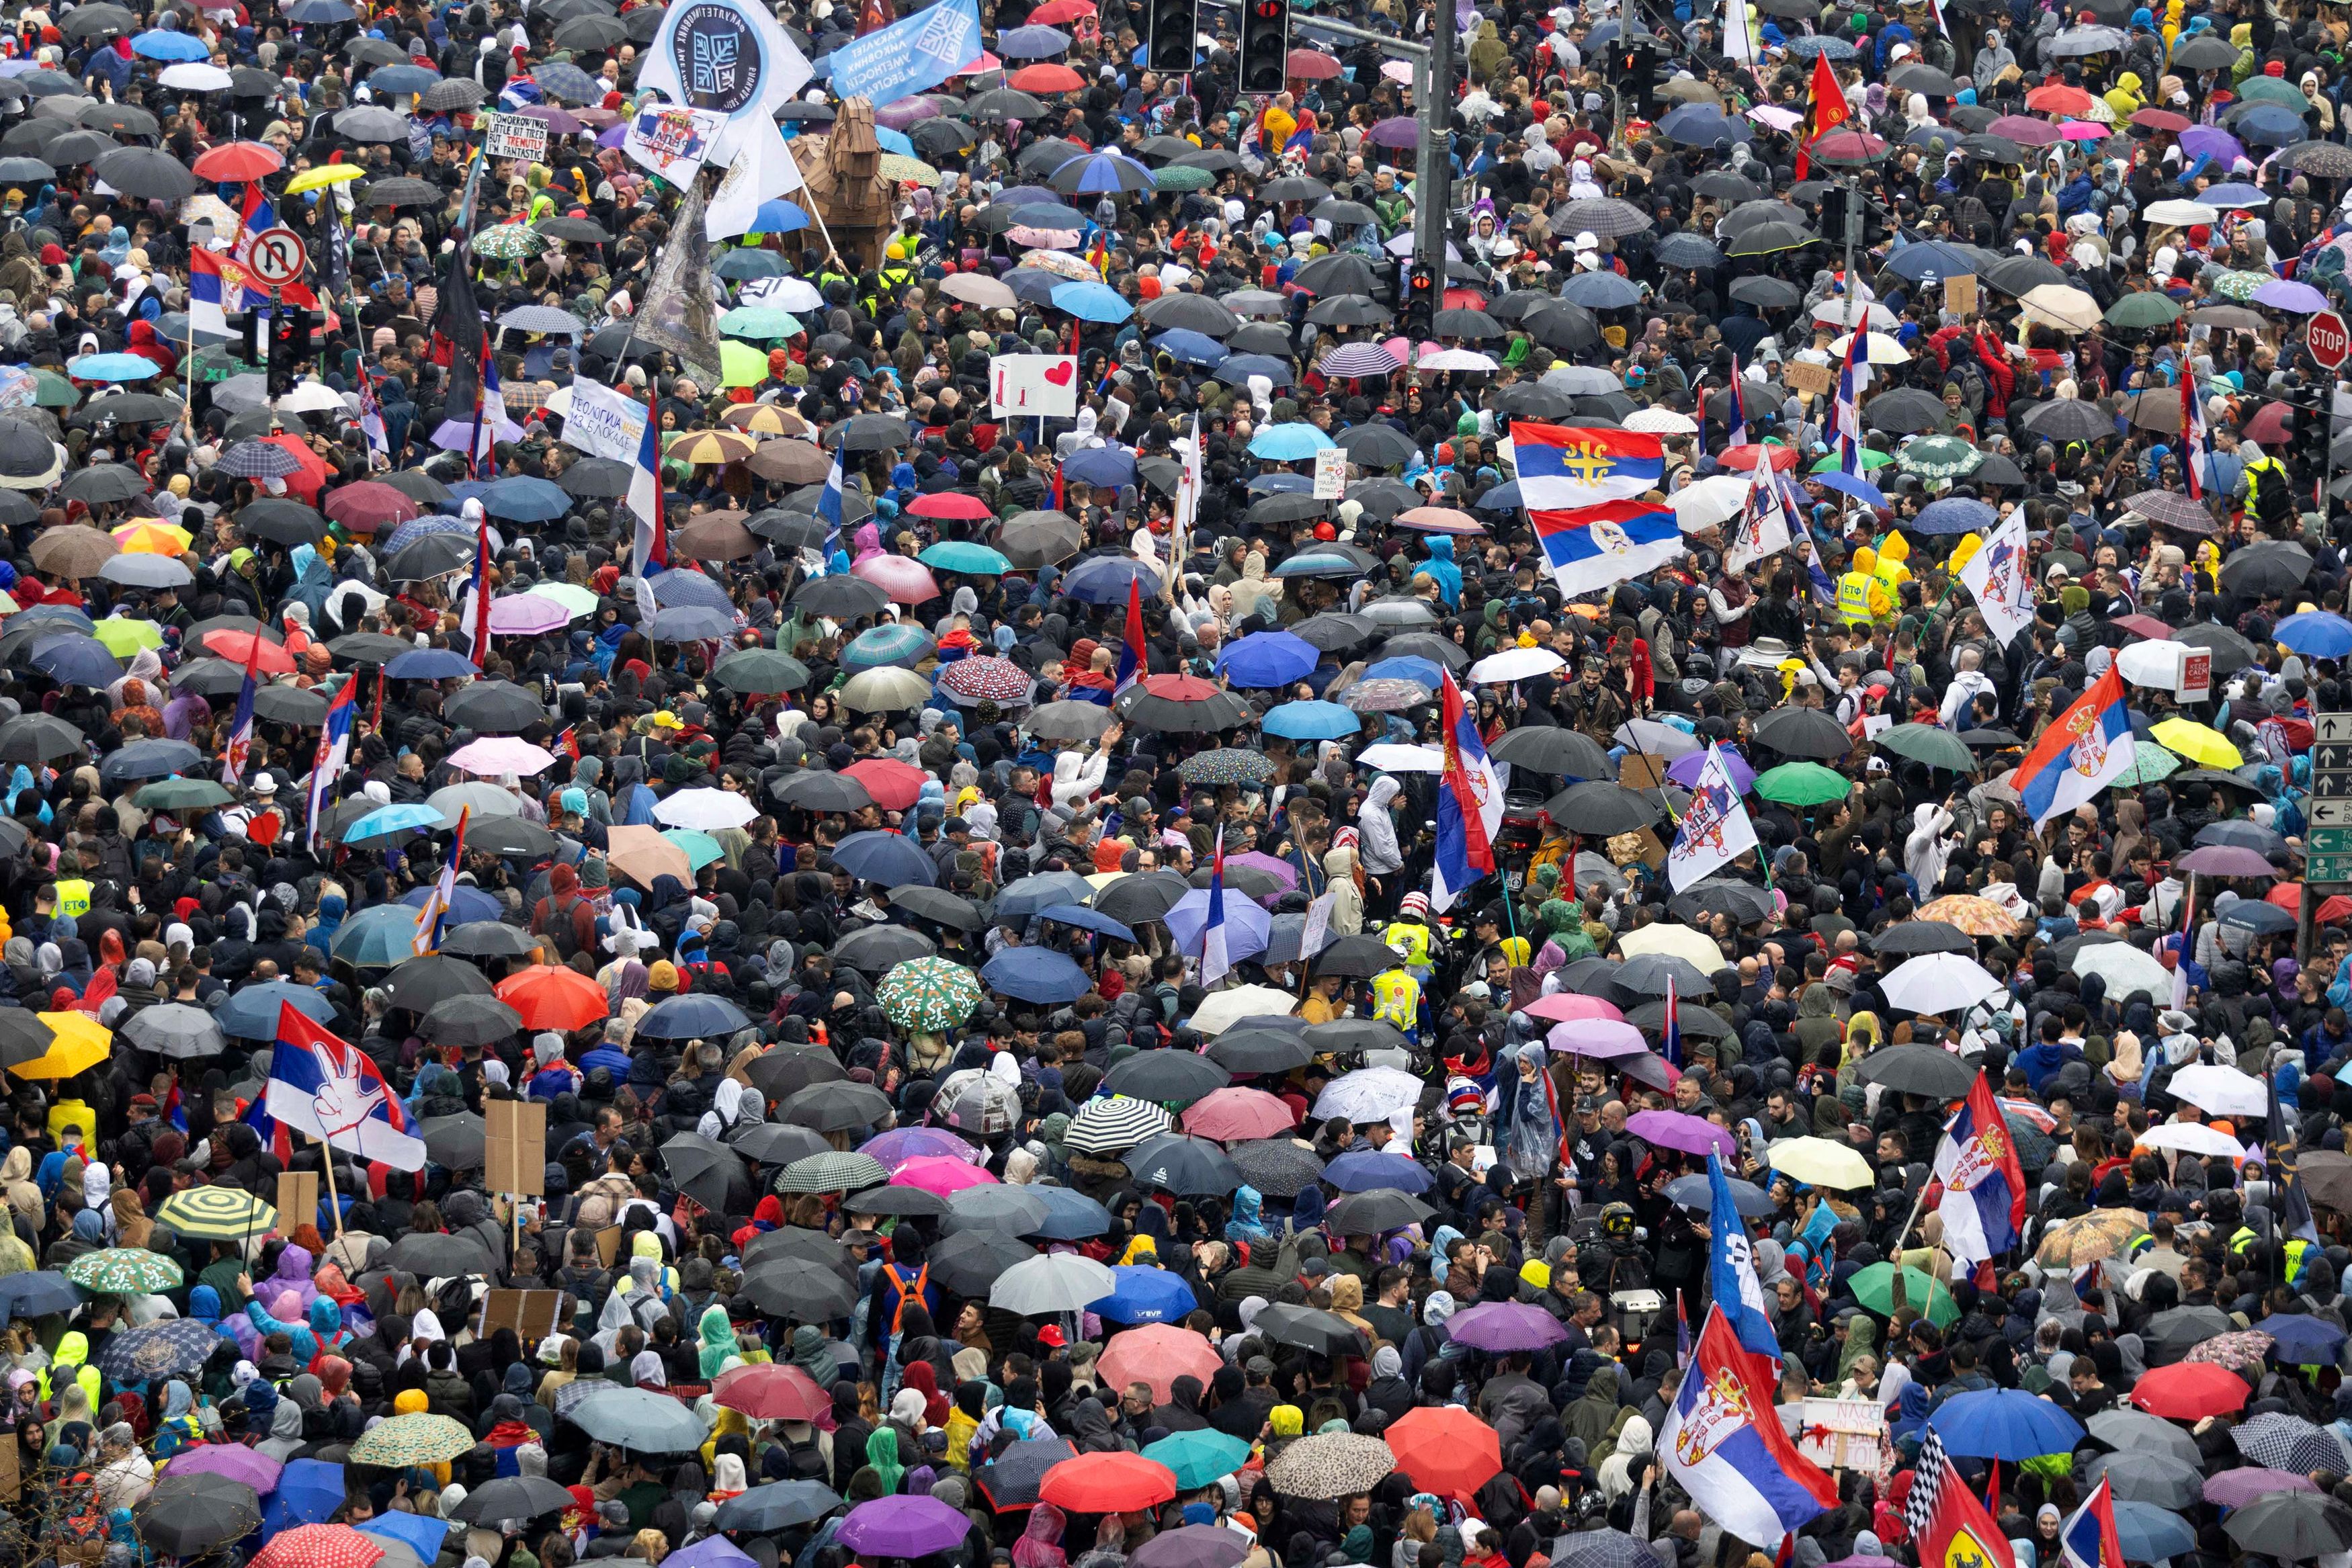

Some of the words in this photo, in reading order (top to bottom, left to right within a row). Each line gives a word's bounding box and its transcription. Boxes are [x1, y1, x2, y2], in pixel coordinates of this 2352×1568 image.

[490, 124, 511, 135] LITTLE
[513, 127, 524, 136] BIT
[489, 134, 501, 144] BUT
[503, 147, 542, 160] FANTASTIC
[2312, 327, 2343, 353] STOP
[571, 394, 621, 431] ТЕОЛОГИЈА
[571, 412, 583, 428] ИЗ
[586, 419, 631, 451] БЛОКАДЕ
[1844, 584, 1861, 595] ЕТФ
[2189, 662, 2207, 672] KEEP
[2188, 669, 2208, 678] CALM
[64, 900, 88, 910] ЕТФ
